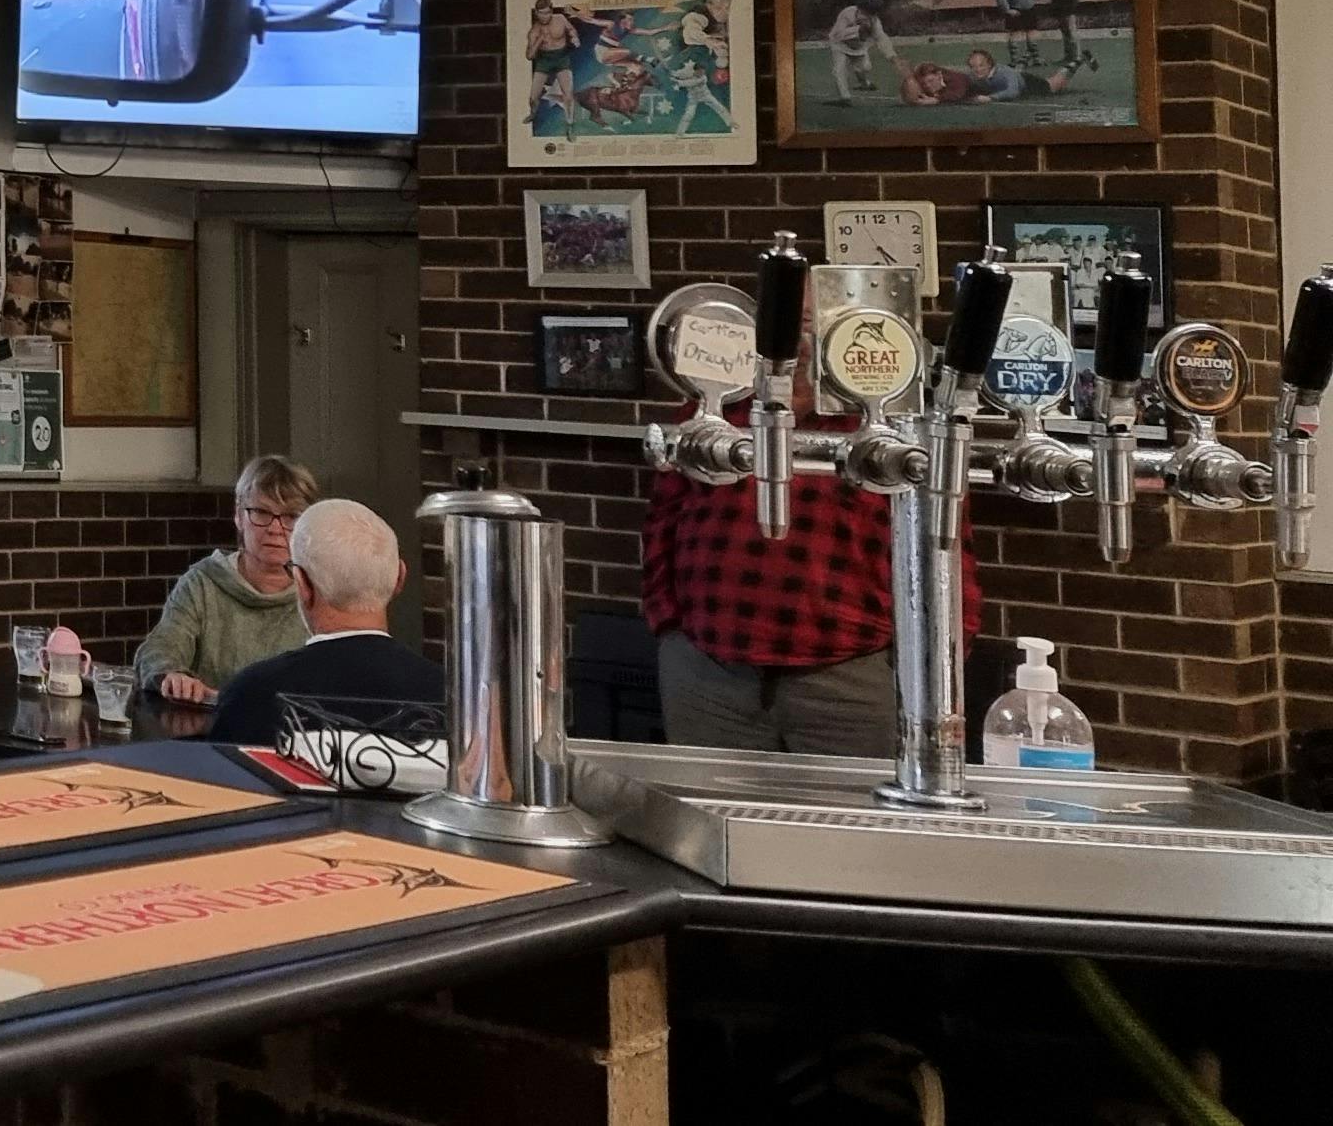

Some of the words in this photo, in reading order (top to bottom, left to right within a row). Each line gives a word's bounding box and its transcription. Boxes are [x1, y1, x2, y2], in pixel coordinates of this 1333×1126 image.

[854, 214, 866, 224] 11
[872, 214, 886, 224] 12
[894, 214, 900, 224] 1
[838, 225, 852, 236] 10
[911, 224, 921, 235] 2
[839, 243, 848, 254] 9
[913, 243, 922, 254] 3
[684, 342, 754, 374] Draught
[843, 350, 900, 365] GREAT
[1176, 355, 1233, 370] CARLTON
[845, 365, 900, 374] NORTHERN
[1004, 361, 1048, 371] CARLTON
[997, 370, 1057, 392] DRY
[236, 871, 381, 907] GREAT
